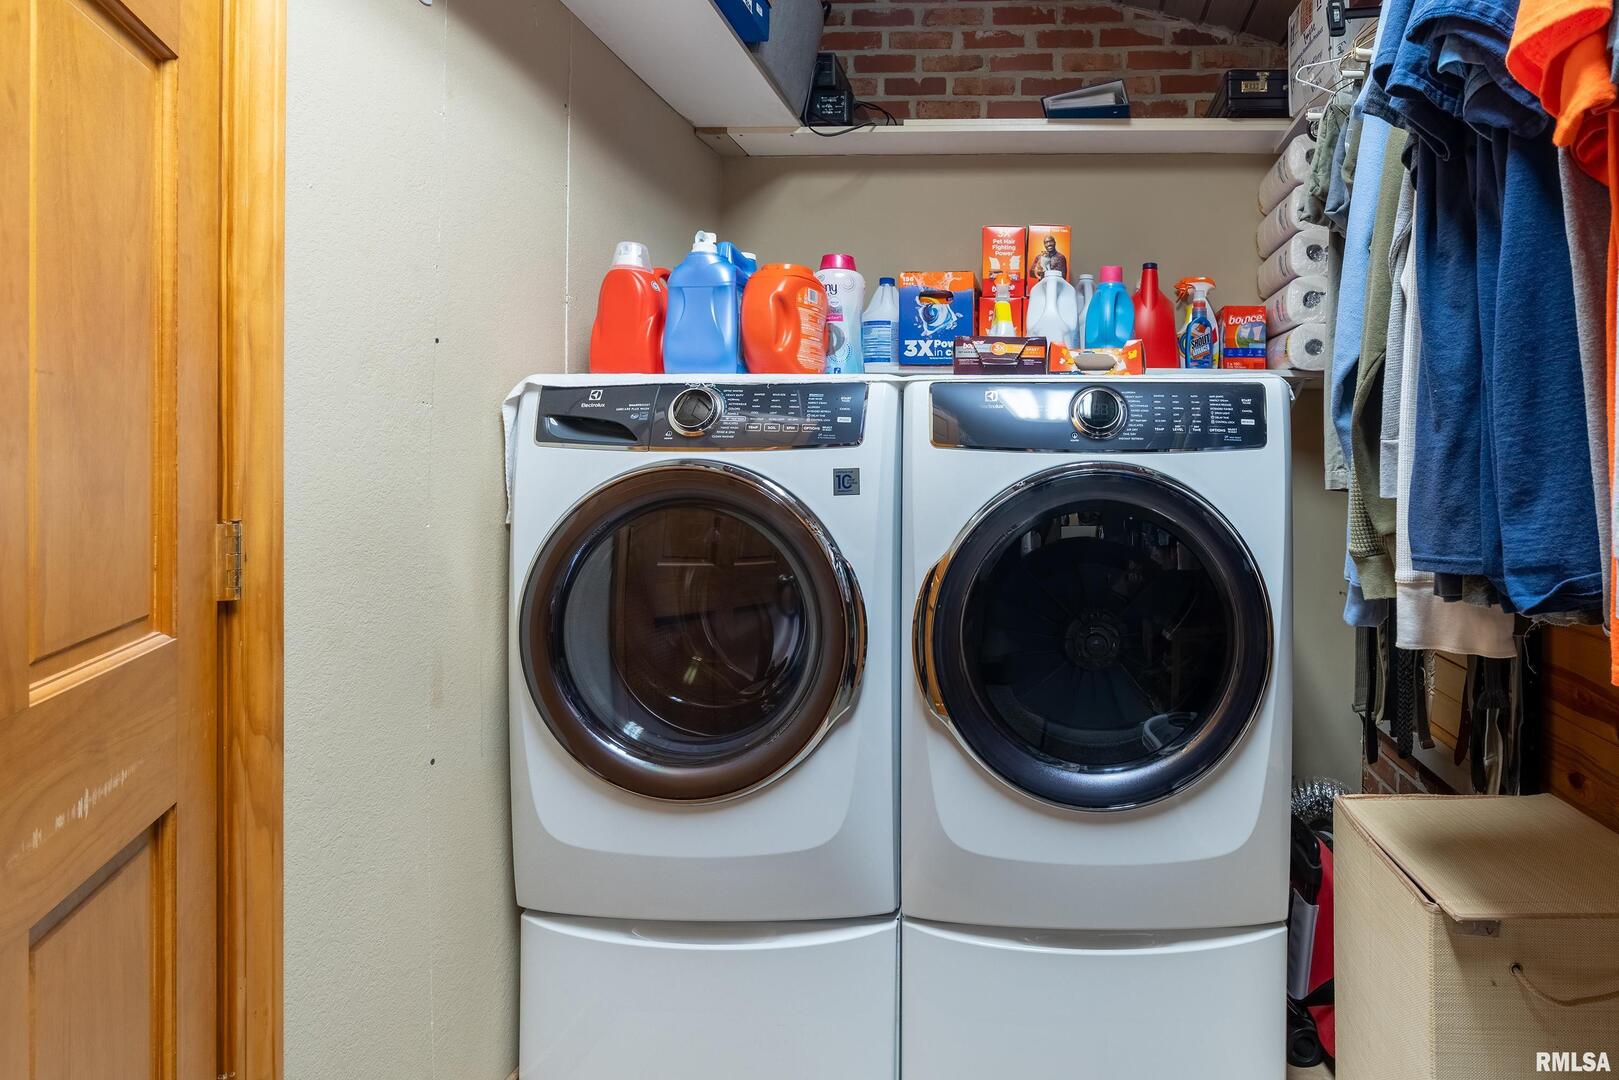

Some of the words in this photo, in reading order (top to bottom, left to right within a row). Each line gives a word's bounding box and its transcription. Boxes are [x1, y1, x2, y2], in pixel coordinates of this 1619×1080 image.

[1228, 314, 1263, 325] bounce
[904, 340, 934, 357] 3X
[934, 348, 943, 356] in
